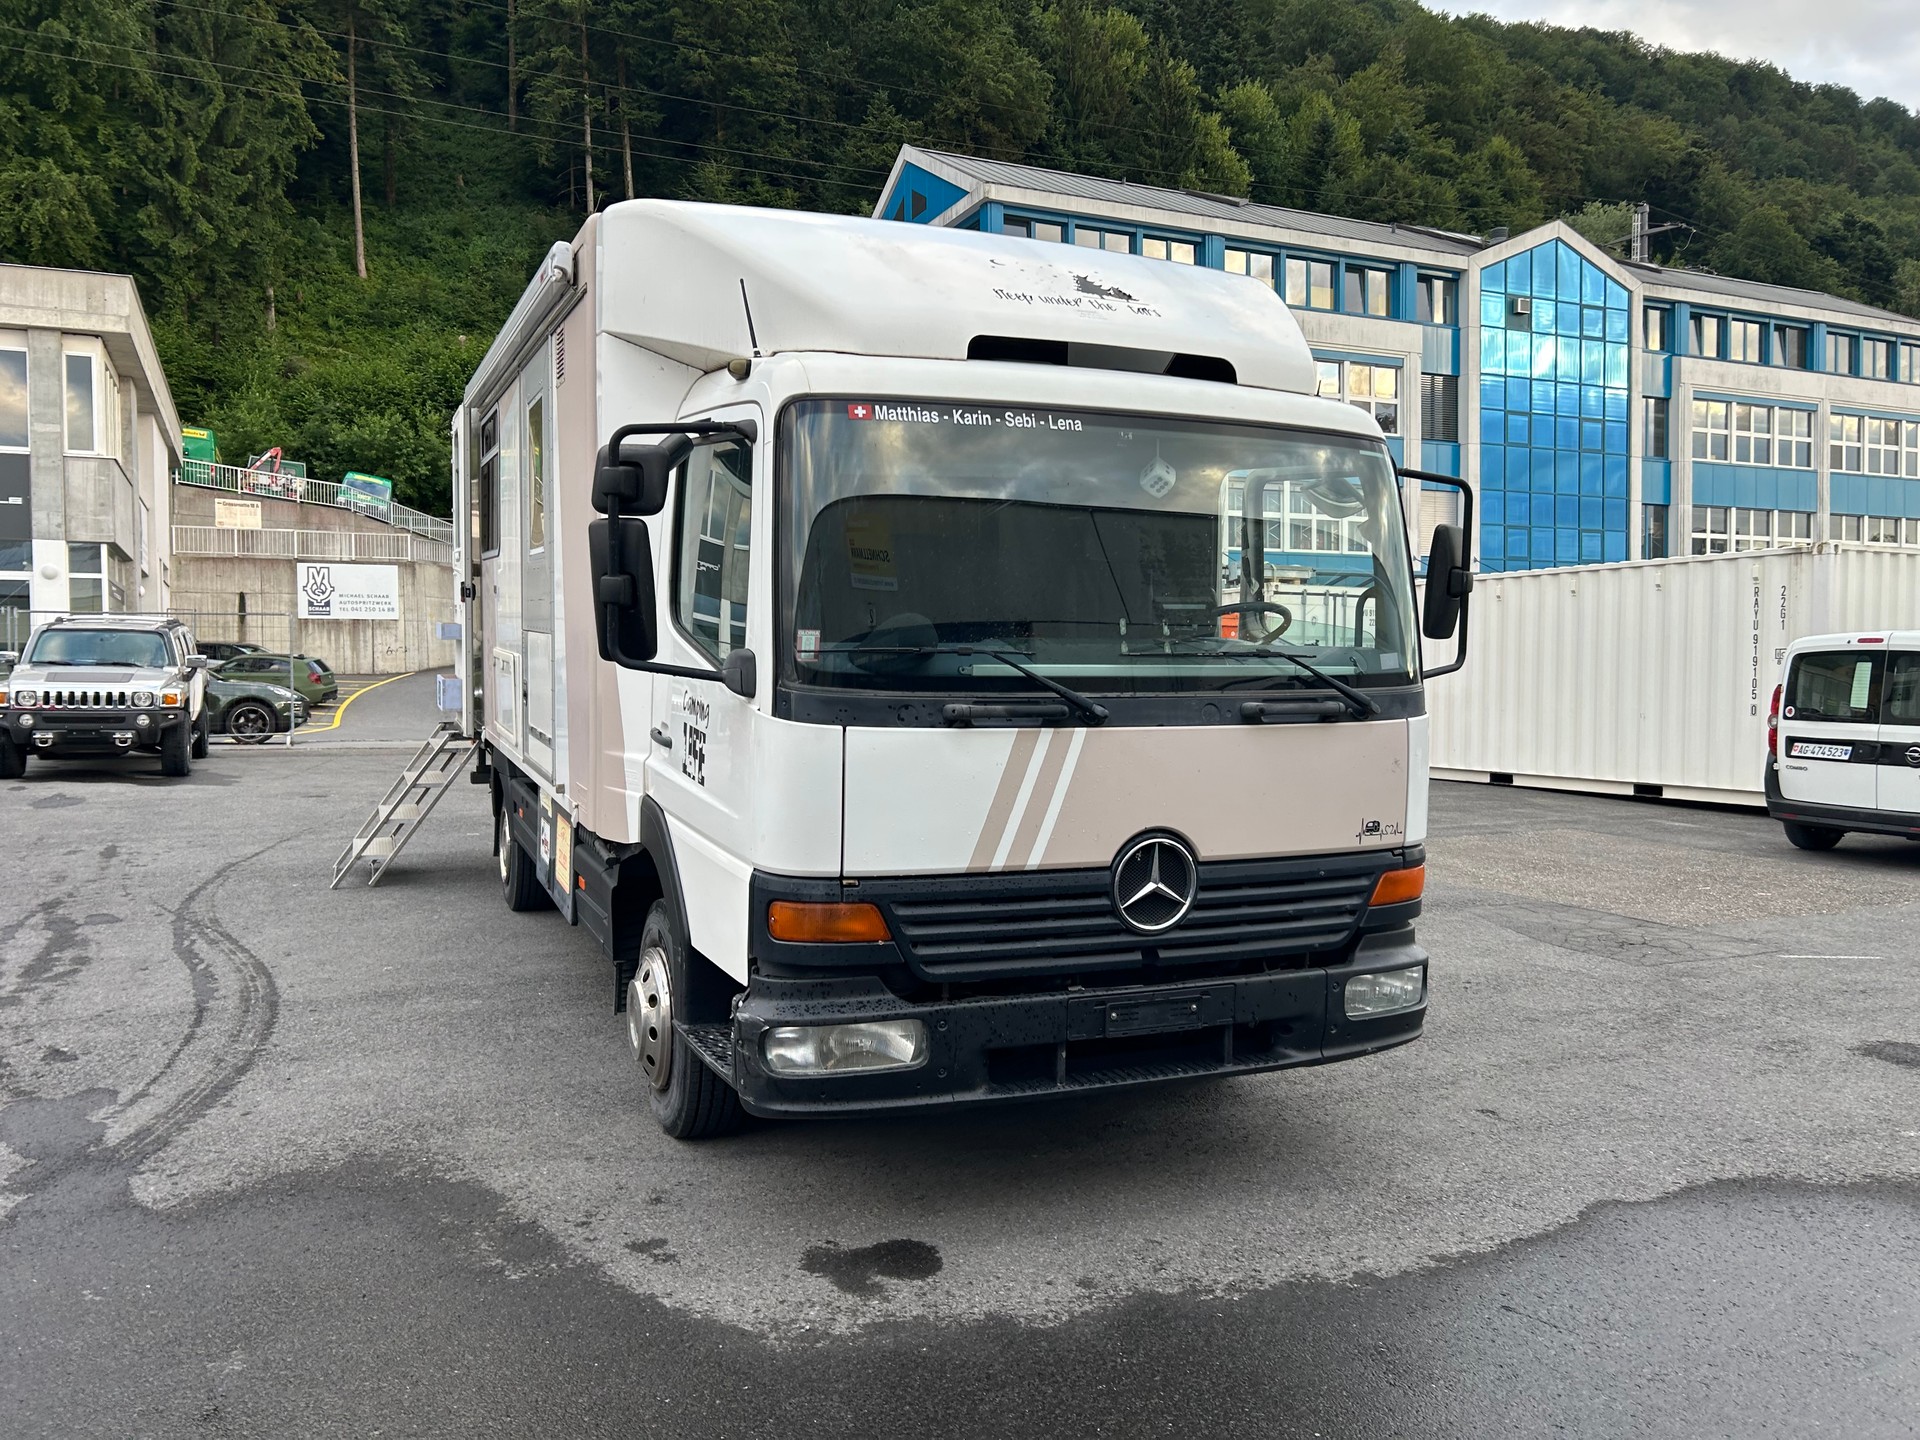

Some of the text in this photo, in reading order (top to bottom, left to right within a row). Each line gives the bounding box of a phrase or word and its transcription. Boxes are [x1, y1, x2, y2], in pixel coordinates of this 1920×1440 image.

[1088, 298, 1117, 312] the
[874, 405, 940, 423] Matthias
[952, 409, 992, 426] Karin
[1004, 411, 1037, 428] Sebi
[1048, 414, 1083, 432] Lena
[1752, 586, 1760, 631] RAYU
[1751, 633, 1759, 701] 919105
